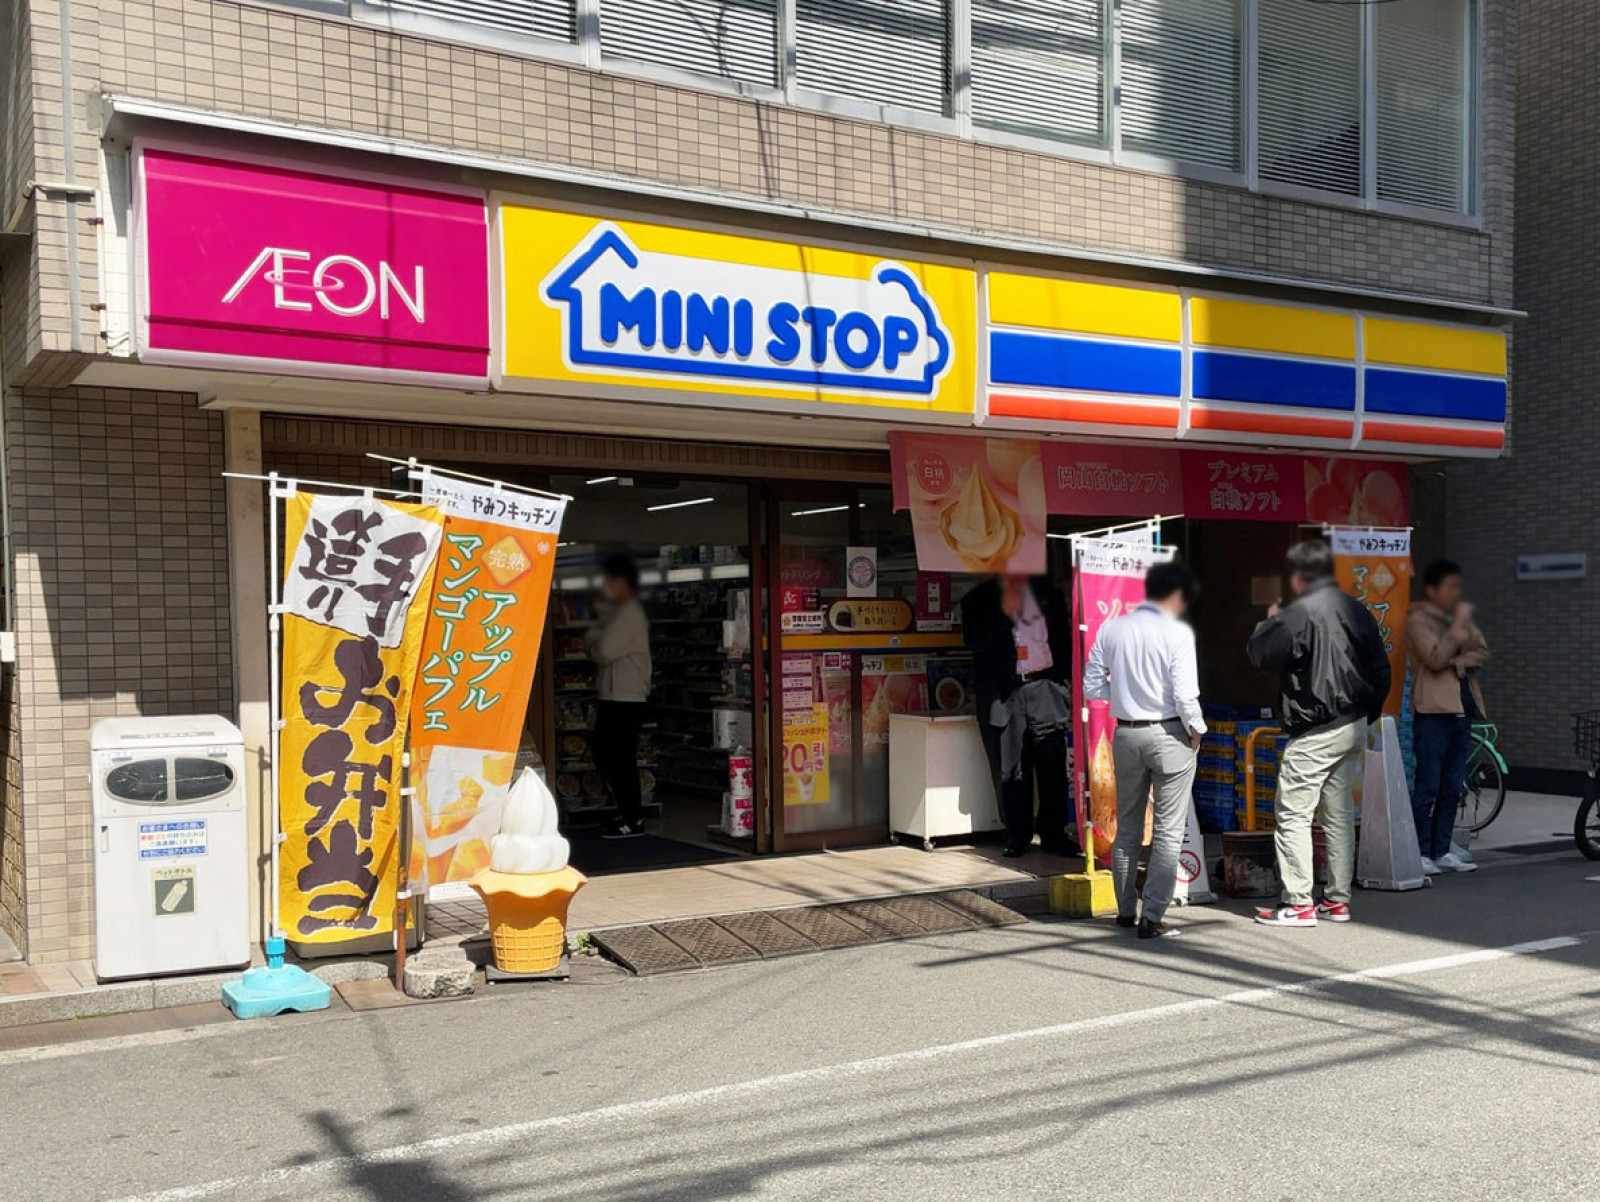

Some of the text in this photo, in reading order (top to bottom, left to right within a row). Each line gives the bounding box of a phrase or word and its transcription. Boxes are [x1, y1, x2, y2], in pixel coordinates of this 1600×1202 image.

[600, 282, 919, 371] MINI STOP
[1208, 459, 1280, 484] プレミアム
[487, 548, 527, 573] 完熟
[422, 531, 485, 733] マンゴーパフェ
[457, 589, 518, 713] アップル
[297, 633, 400, 936] お弁当
[156, 868, 193, 876] ペットボトル
